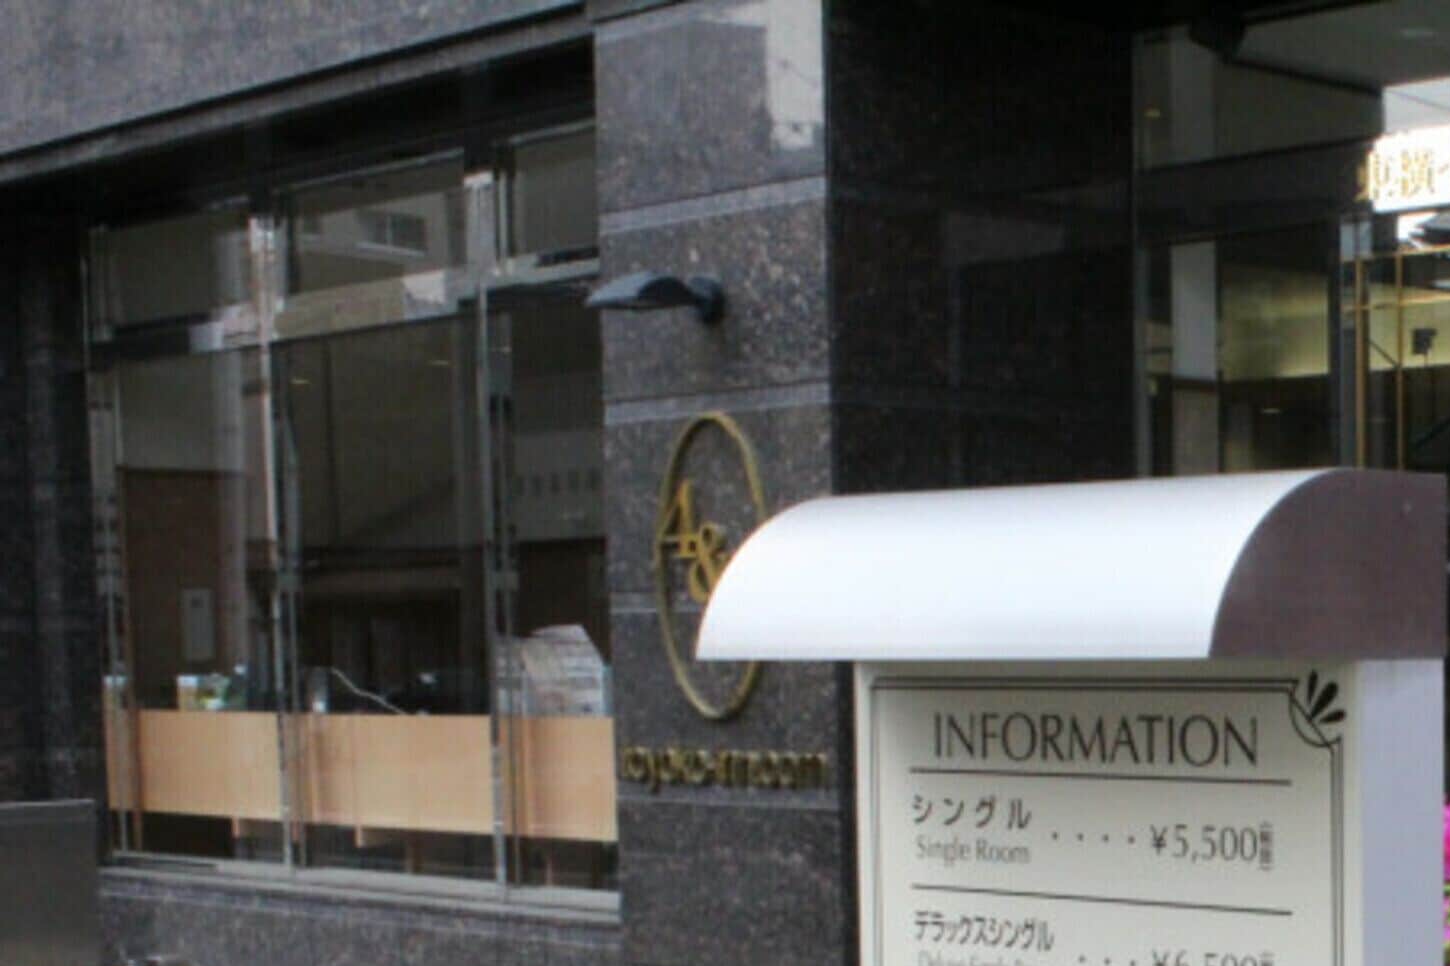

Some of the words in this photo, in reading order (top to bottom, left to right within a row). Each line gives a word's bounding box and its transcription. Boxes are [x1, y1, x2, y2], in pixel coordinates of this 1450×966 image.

[933, 711, 1260, 769] INFORMATION
[911, 795, 1032, 830] シングル
[916, 835, 971, 867] Single
[976, 839, 1030, 864] Room
[1150, 823, 1258, 865] ¥5,500
[914, 910, 1055, 952] デラックスシングル
